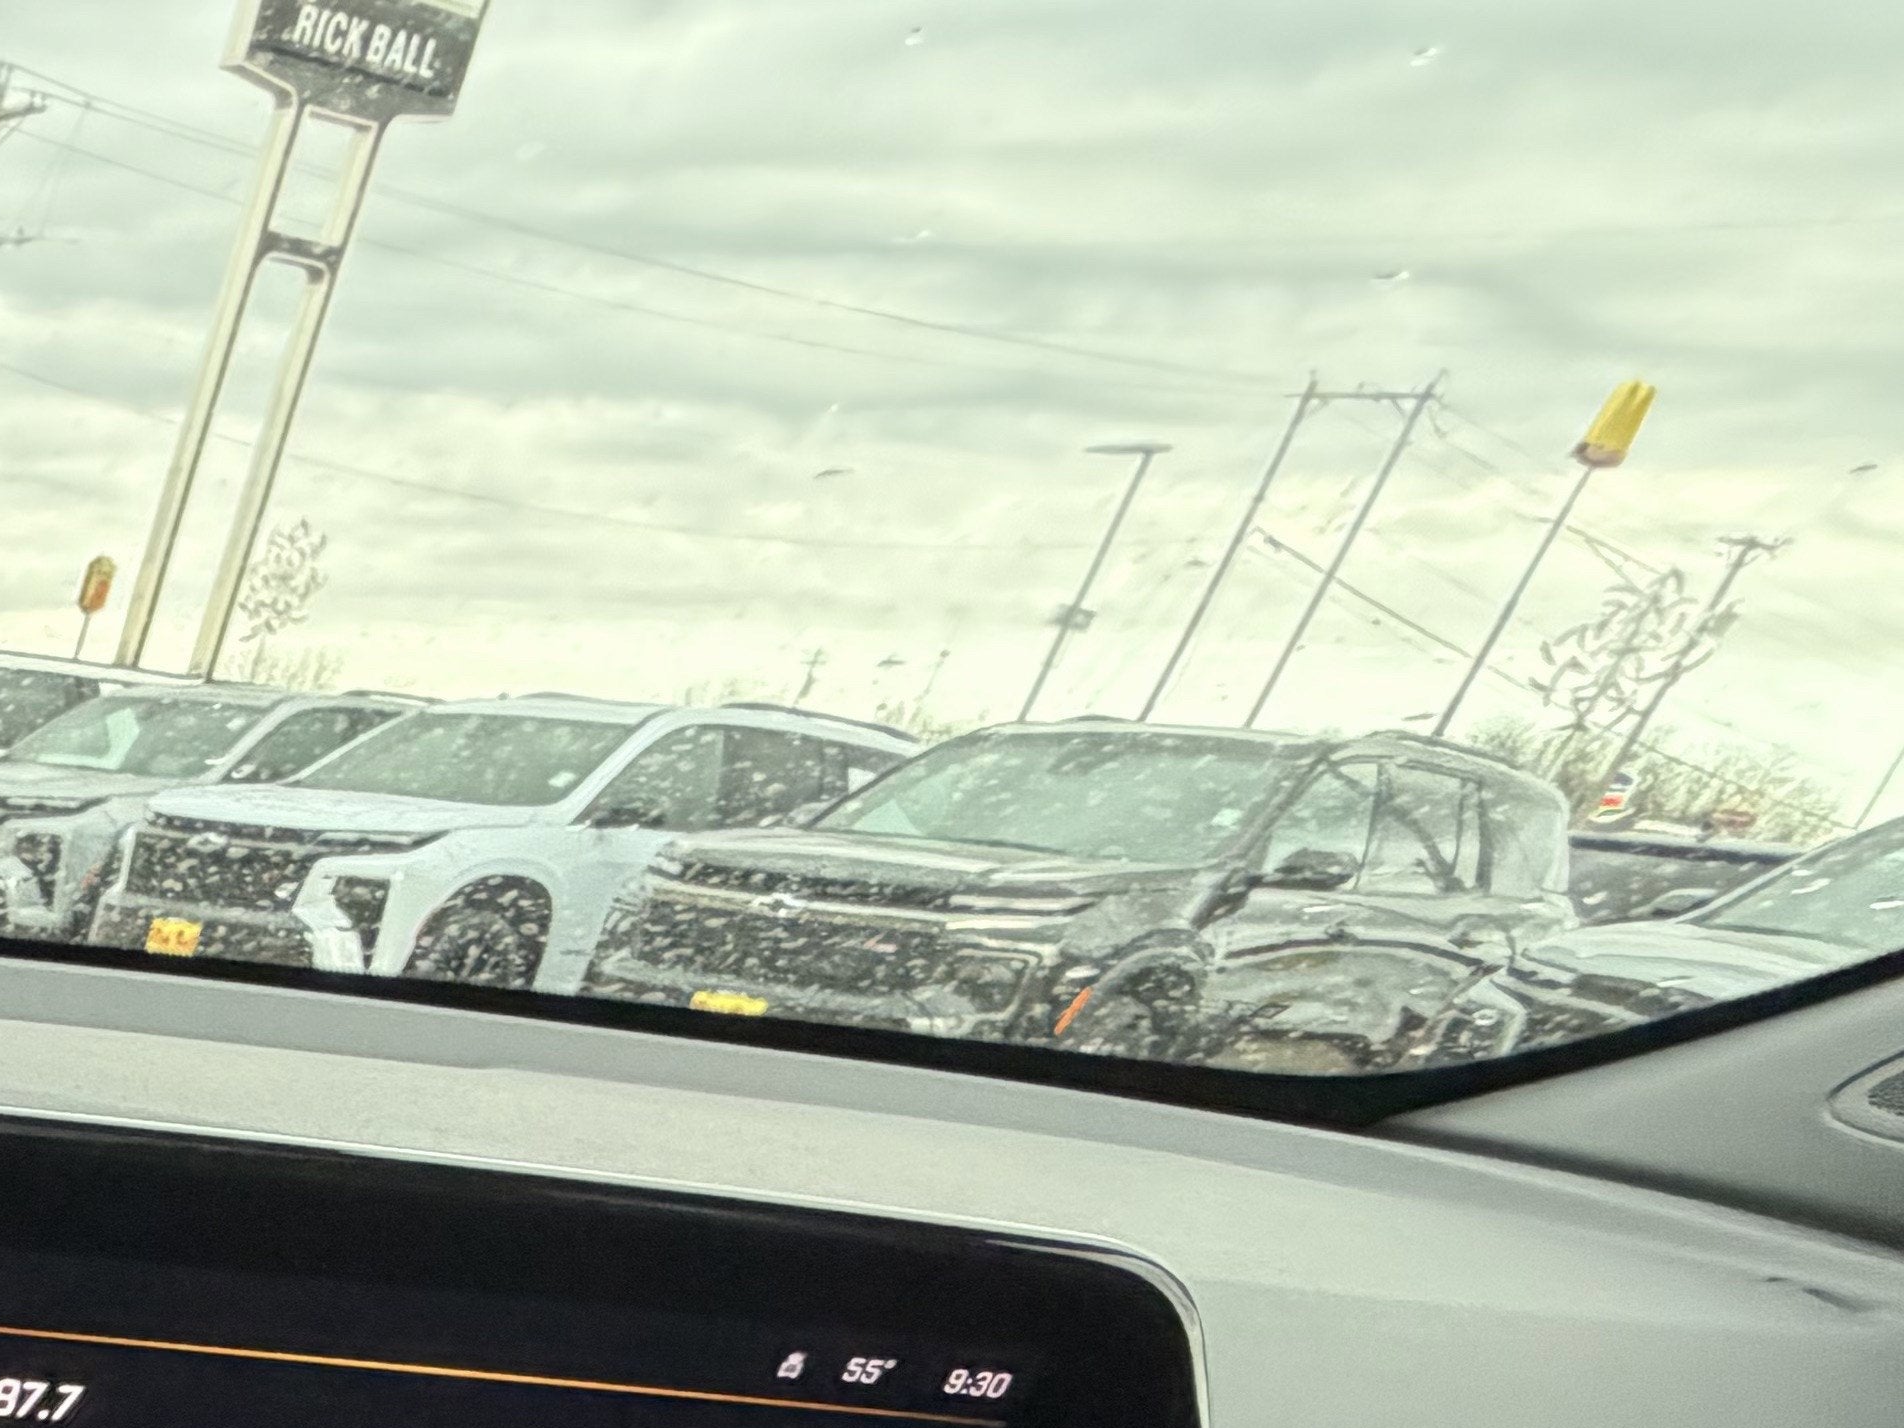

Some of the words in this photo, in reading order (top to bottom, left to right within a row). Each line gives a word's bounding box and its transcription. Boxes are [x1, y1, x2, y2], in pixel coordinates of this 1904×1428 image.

[293, 4, 369, 58] RICK
[366, 24, 438, 79] BALL
[943, 1368, 1013, 1398] 9:30
